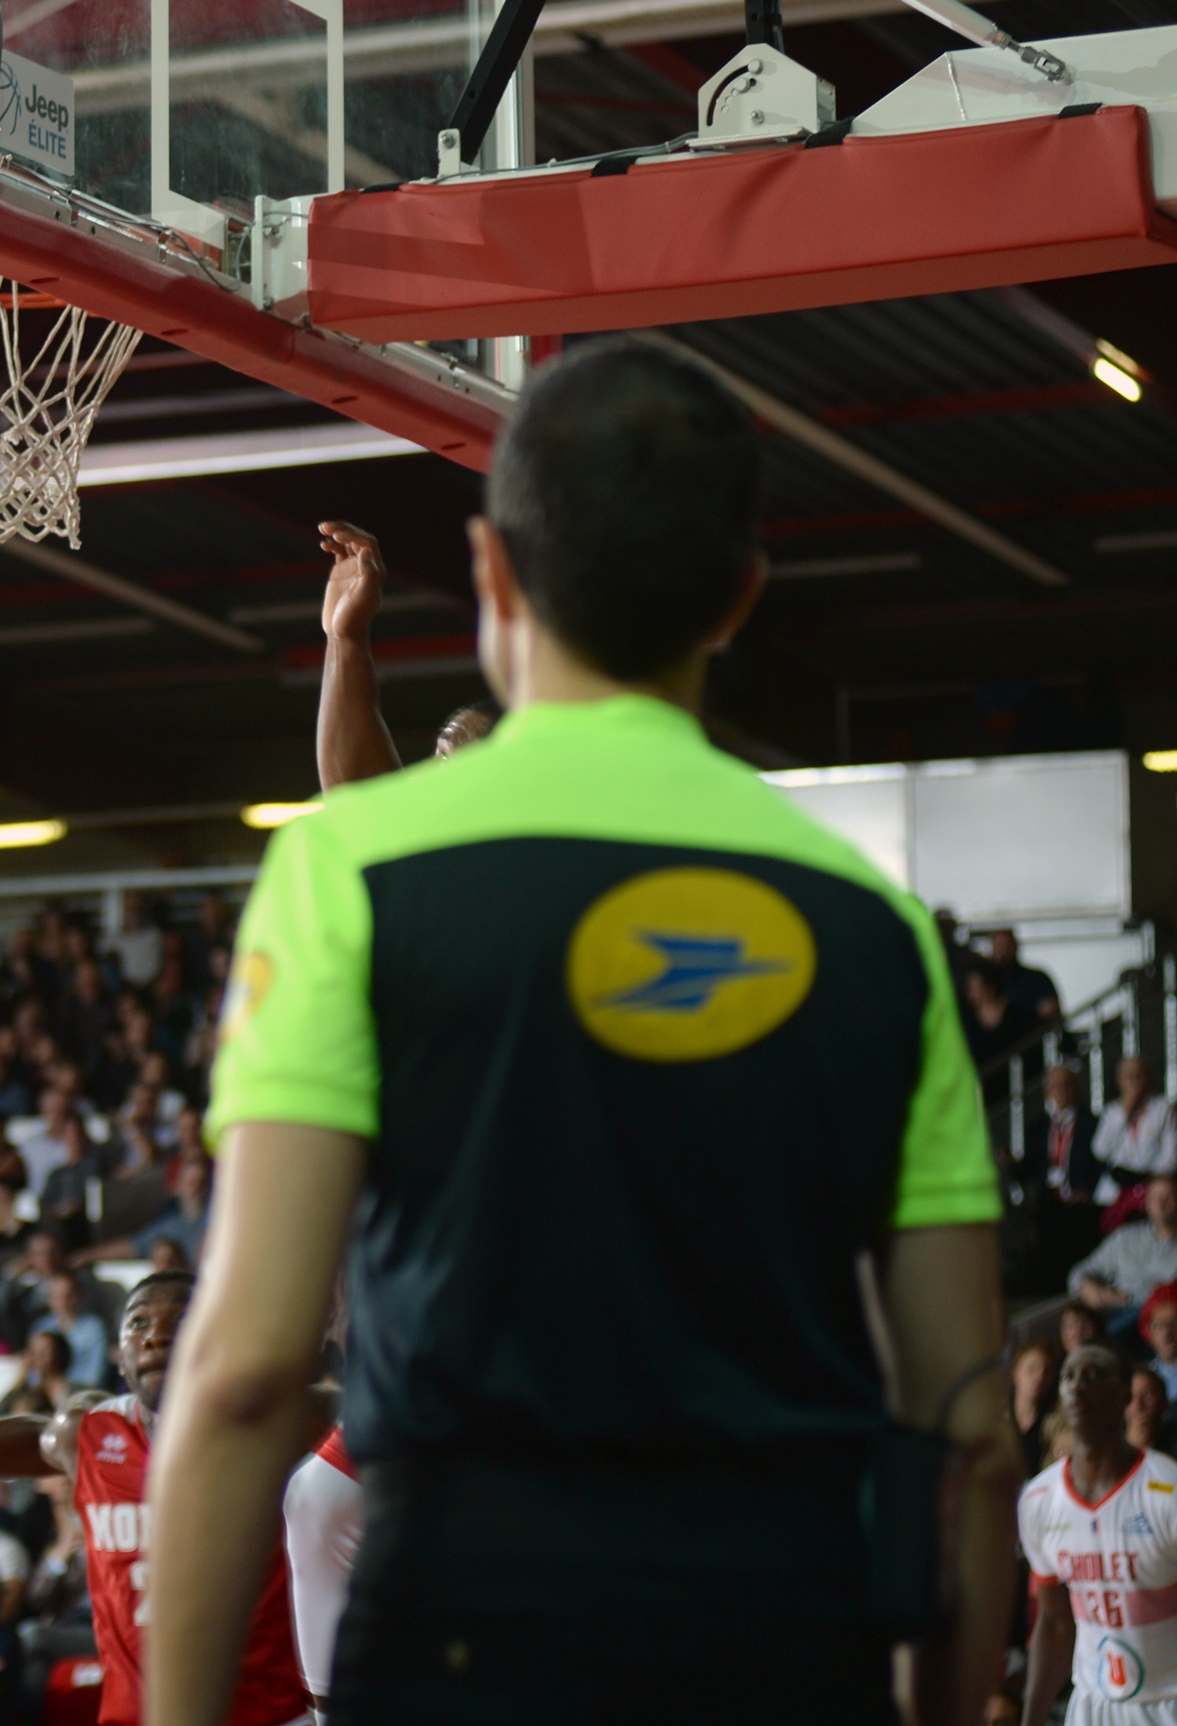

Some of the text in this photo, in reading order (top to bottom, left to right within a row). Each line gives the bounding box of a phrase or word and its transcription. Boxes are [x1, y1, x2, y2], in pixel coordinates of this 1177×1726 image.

[25, 84, 69, 132] Jeep
[29, 118, 67, 159] ÉLITE
[1058, 1550, 1140, 1582] CHOLET
